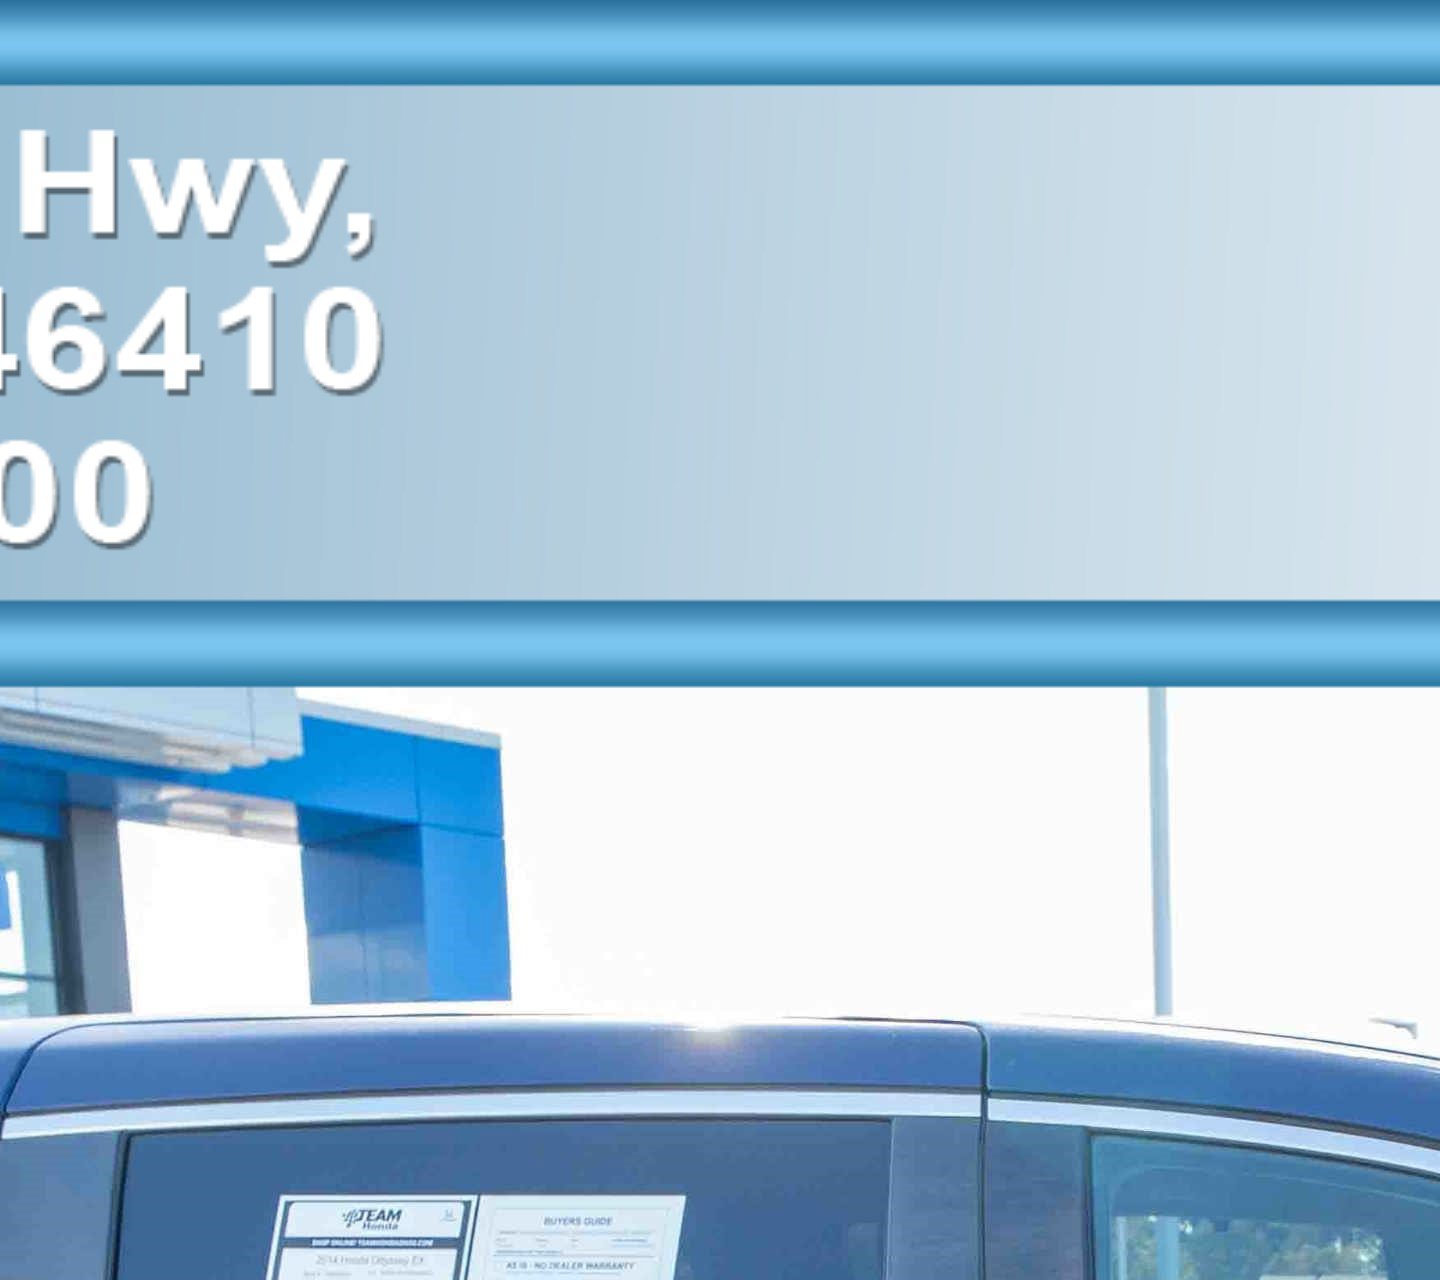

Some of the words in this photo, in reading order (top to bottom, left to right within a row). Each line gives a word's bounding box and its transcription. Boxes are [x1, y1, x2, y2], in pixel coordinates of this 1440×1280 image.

[358, 1209, 402, 1222] TEAM
[543, 1216, 581, 1226] BUYERS
[583, 1216, 614, 1226] GUIDE
[362, 1222, 399, 1231] Honda
[506, 1261, 517, 1270] AS
[534, 1261, 547, 1270] NO
[548, 1261, 584, 1270] DEALER
[585, 1261, 636, 1270] WARRANTY
